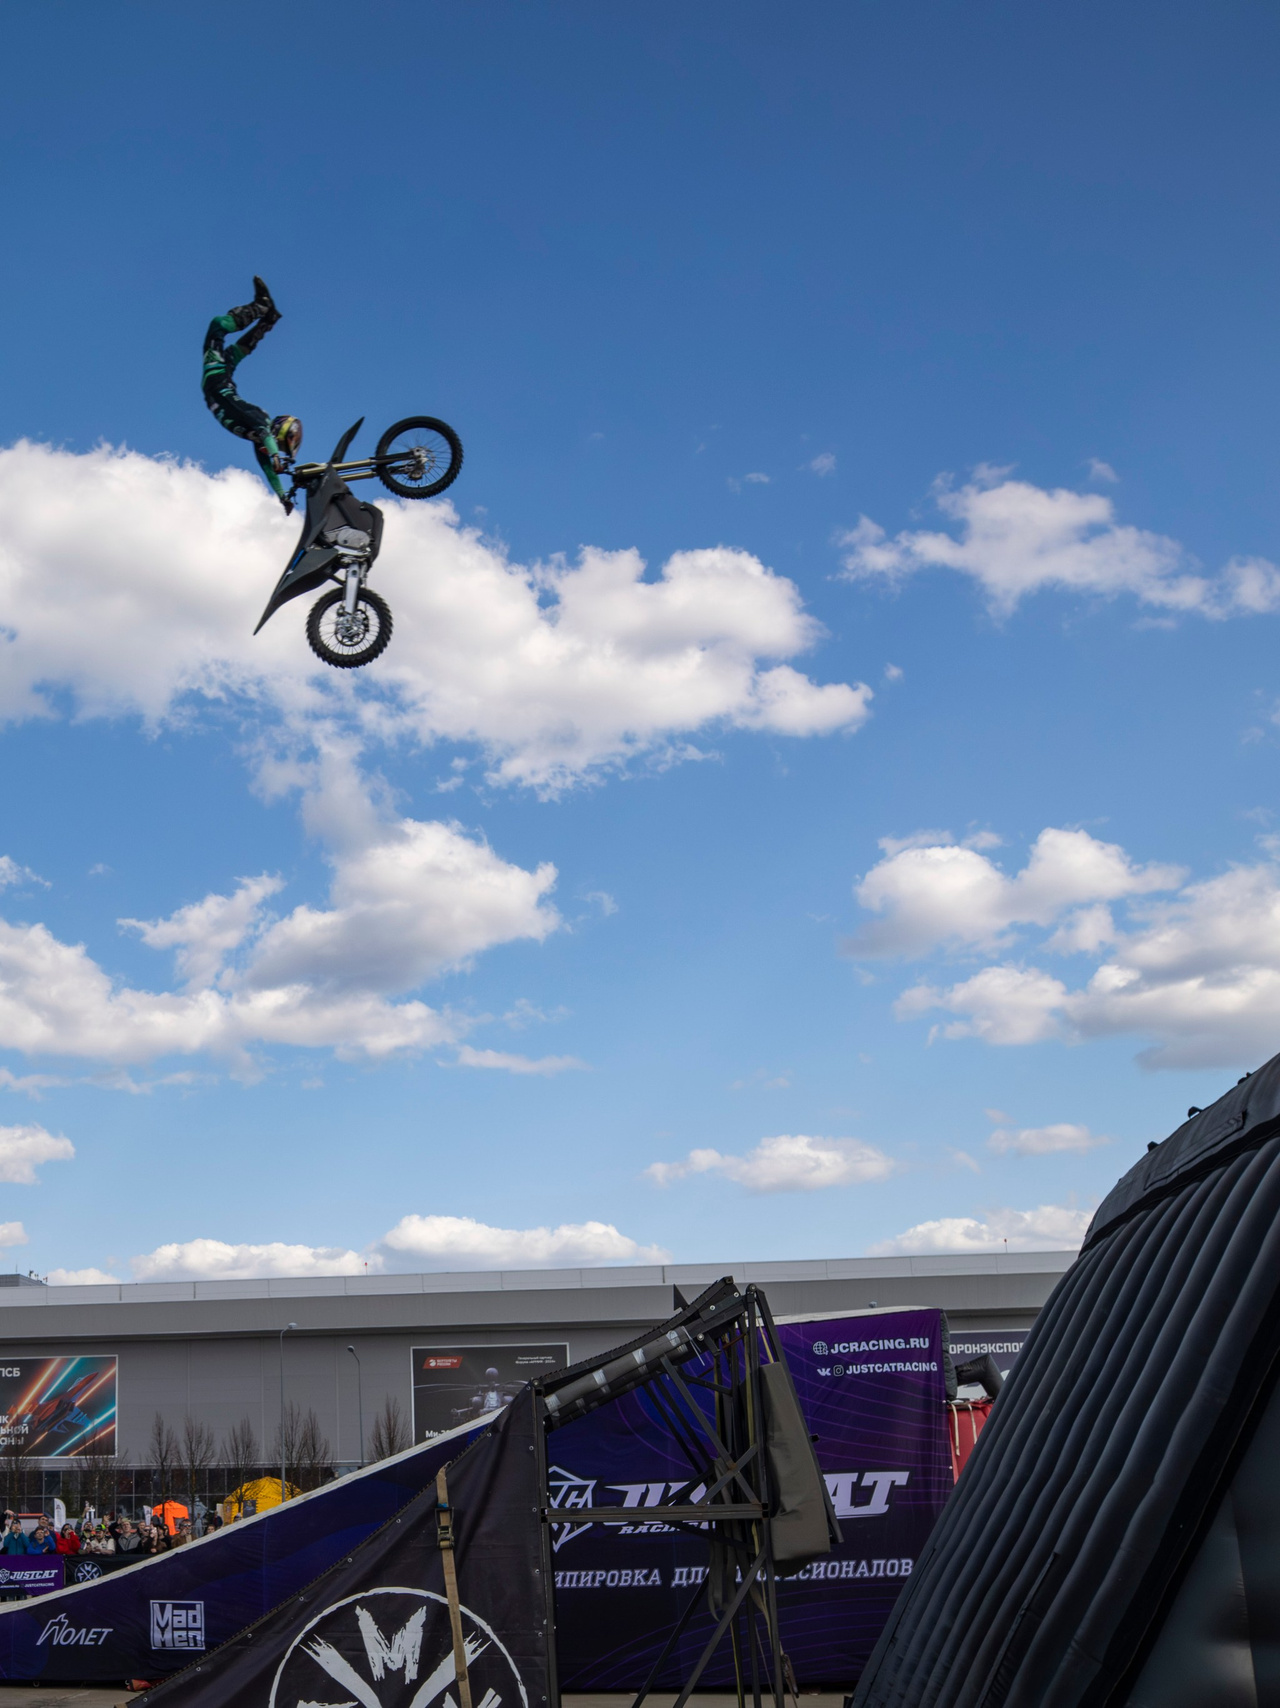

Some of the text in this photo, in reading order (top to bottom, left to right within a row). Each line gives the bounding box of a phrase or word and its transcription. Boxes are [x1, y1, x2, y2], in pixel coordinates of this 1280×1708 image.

[830, 1337, 930, 1354] JCRACING.RU
[846, 1361, 938, 1375] JUSTCATRACING
[10, 1569, 59, 1581] JUSTCAT
[554, 1568, 662, 1589] ИПИРОВКА
[671, 1566, 710, 1588] ДЛ
[153, 1603, 202, 1630] Mad
[153, 1627, 205, 1648] Men
